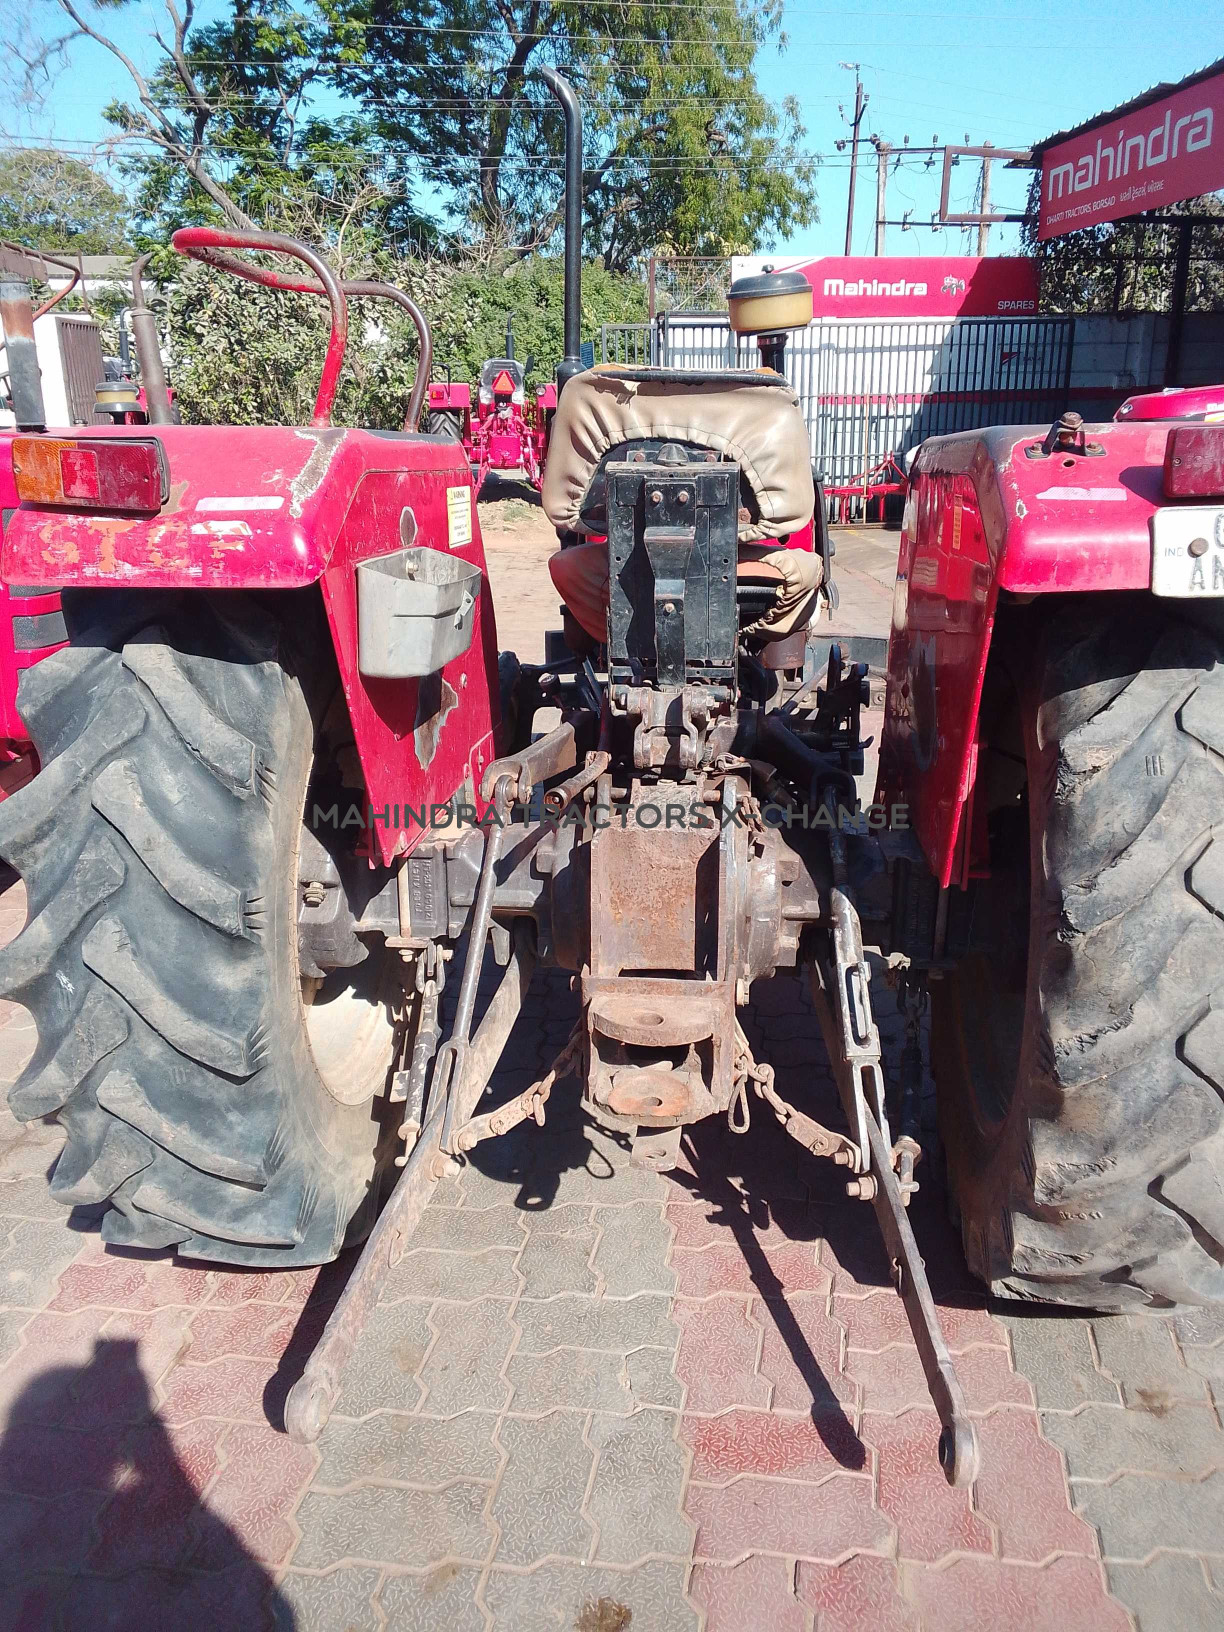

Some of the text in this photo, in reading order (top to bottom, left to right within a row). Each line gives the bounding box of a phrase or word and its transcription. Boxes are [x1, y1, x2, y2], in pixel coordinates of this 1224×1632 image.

[1048, 107, 1214, 201] mahindra
[1092, 195, 1116, 211] BORSAD
[824, 279, 927, 296] Mahindra
[997, 300, 1035, 310] SPARES
